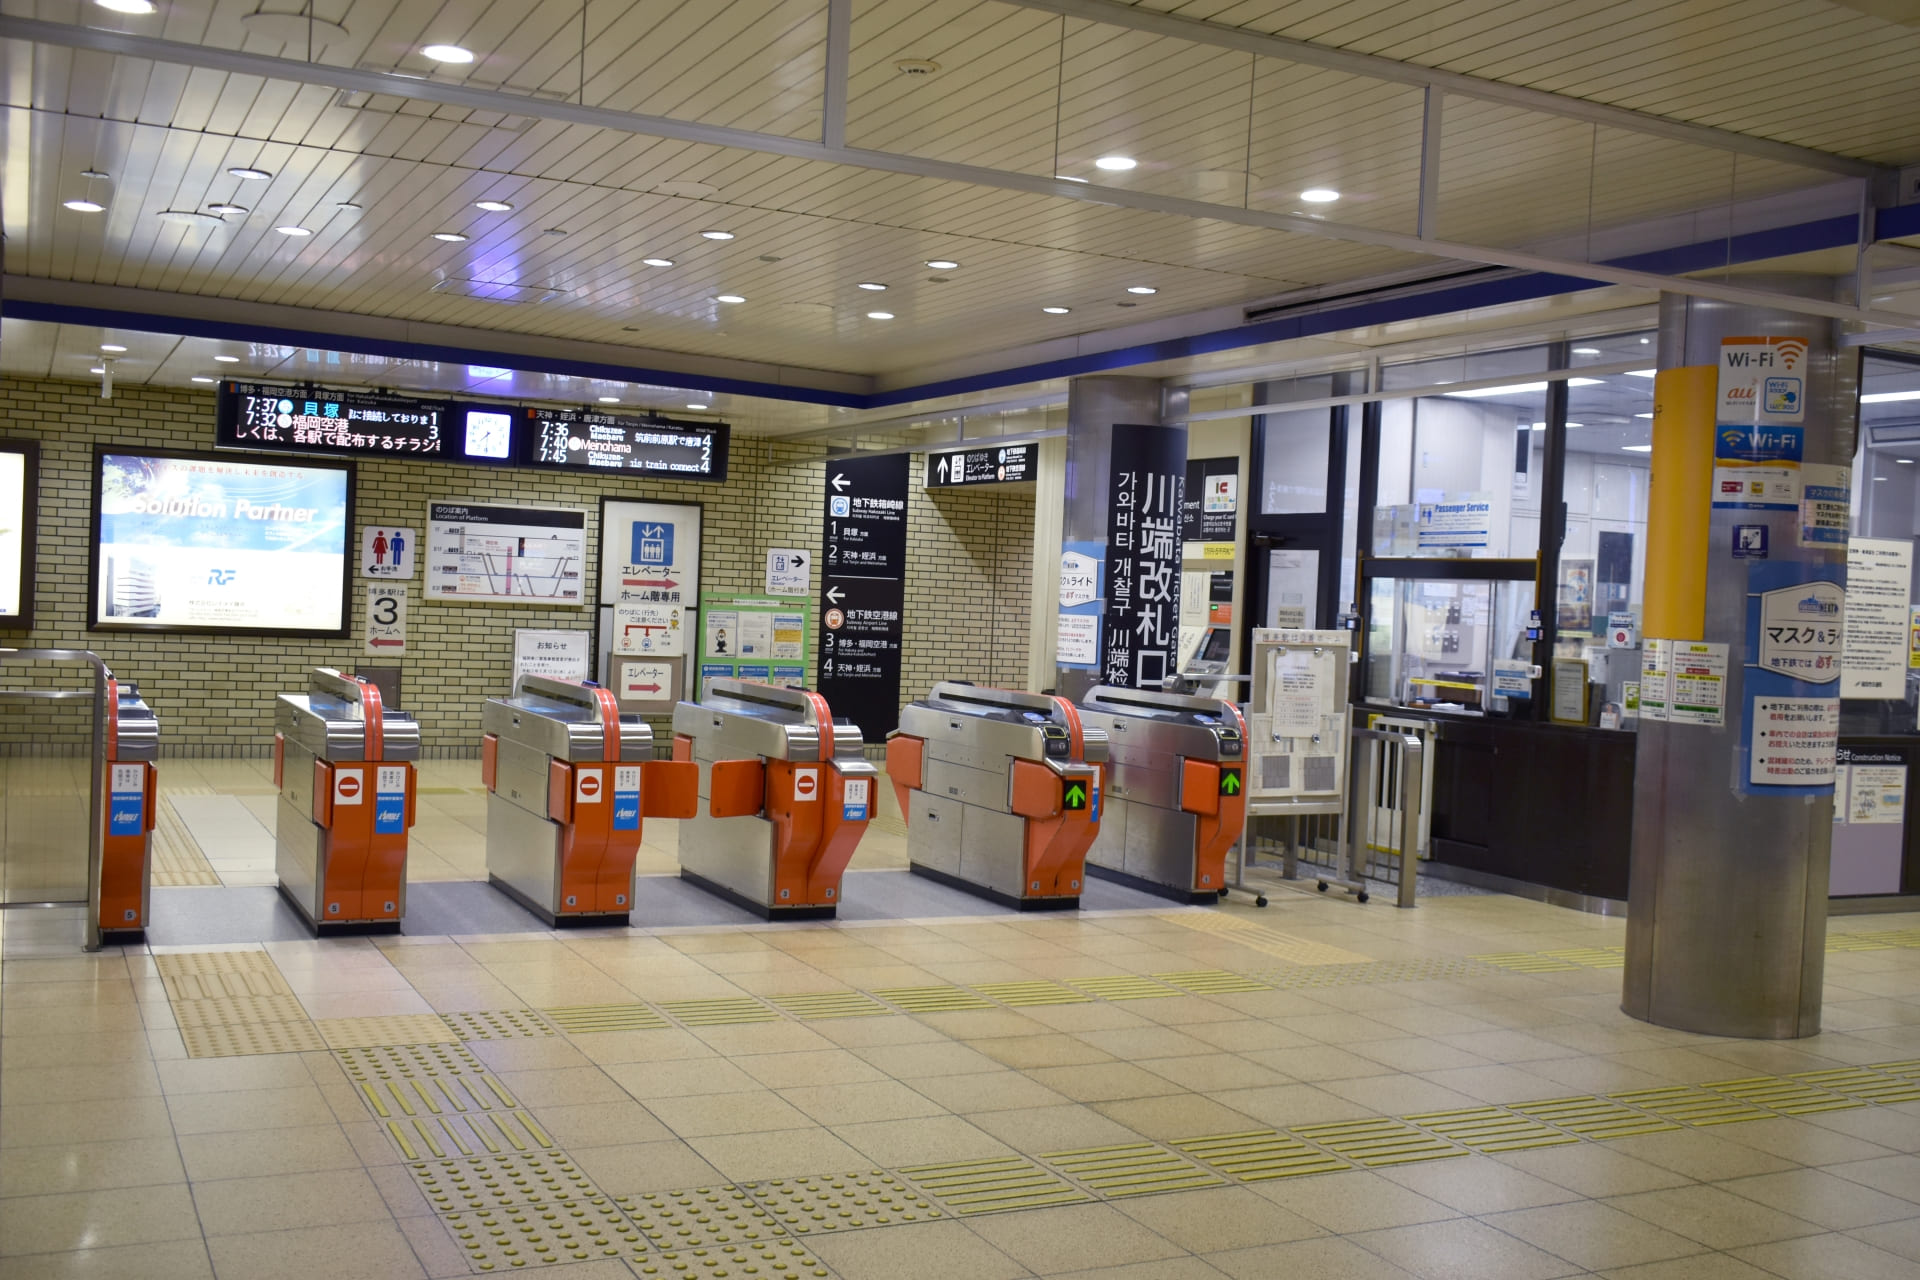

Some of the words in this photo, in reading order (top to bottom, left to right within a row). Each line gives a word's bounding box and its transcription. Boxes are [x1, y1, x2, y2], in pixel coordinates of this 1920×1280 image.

[1727, 352, 1774, 367] Wi-Fi
[1728, 387, 1756, 399] au
[246, 396, 278, 413] 7:37
[430, 411, 438, 425] 1
[245, 410, 277, 427] 7:32
[292, 414, 350, 434] 福岡空港
[428, 425, 439, 440] 3
[541, 421, 569, 437] 7:36
[702, 433, 712, 449] 4
[1749, 433, 1796, 449] Wi-Fi
[539, 447, 567, 463] 7:45
[540, 435, 568, 450] 7:40
[581, 439, 632, 454] Meinohama
[700, 446, 711, 461] 2
[645, 460, 668, 470] train
[669, 463, 700, 473] connect
[700, 460, 711, 474] 4
[965, 463, 995, 473] エレベーター
[134, 496, 227, 519] Solution
[233, 499, 319, 523] Partner
[852, 496, 904, 510] 地下鉄箱崎線
[1183, 501, 1200, 510] ment
[1435, 504, 1466, 513] Passenger
[1467, 503, 1489, 512] Service
[435, 513, 458, 521] Location
[1116, 471, 1138, 551] 가와바타
[830, 520, 837, 535] 1
[1174, 475, 1185, 565] Kawabata
[828, 544, 838, 559] 2
[207, 568, 237, 586] RF
[622, 566, 681, 577] エレベーター
[1111, 557, 1133, 617] 개찰구
[1135, 472, 1177, 688] 川端改札口
[368, 587, 406, 597] 博多駅は
[621, 590, 681, 603] ホーム階専用
[1171, 572, 1180, 619] Ticket
[373, 597, 399, 626] 3
[846, 608, 899, 621] 地下鉄空港線
[369, 627, 401, 636] ホームへ
[537, 642, 568, 650] お知らせ
[825, 632, 835, 648] 3
[1169, 626, 1178, 668] Gate
[627, 667, 664, 678] エレベーター
[823, 658, 834, 673] 4
[1851, 753, 1883, 761] Construction
